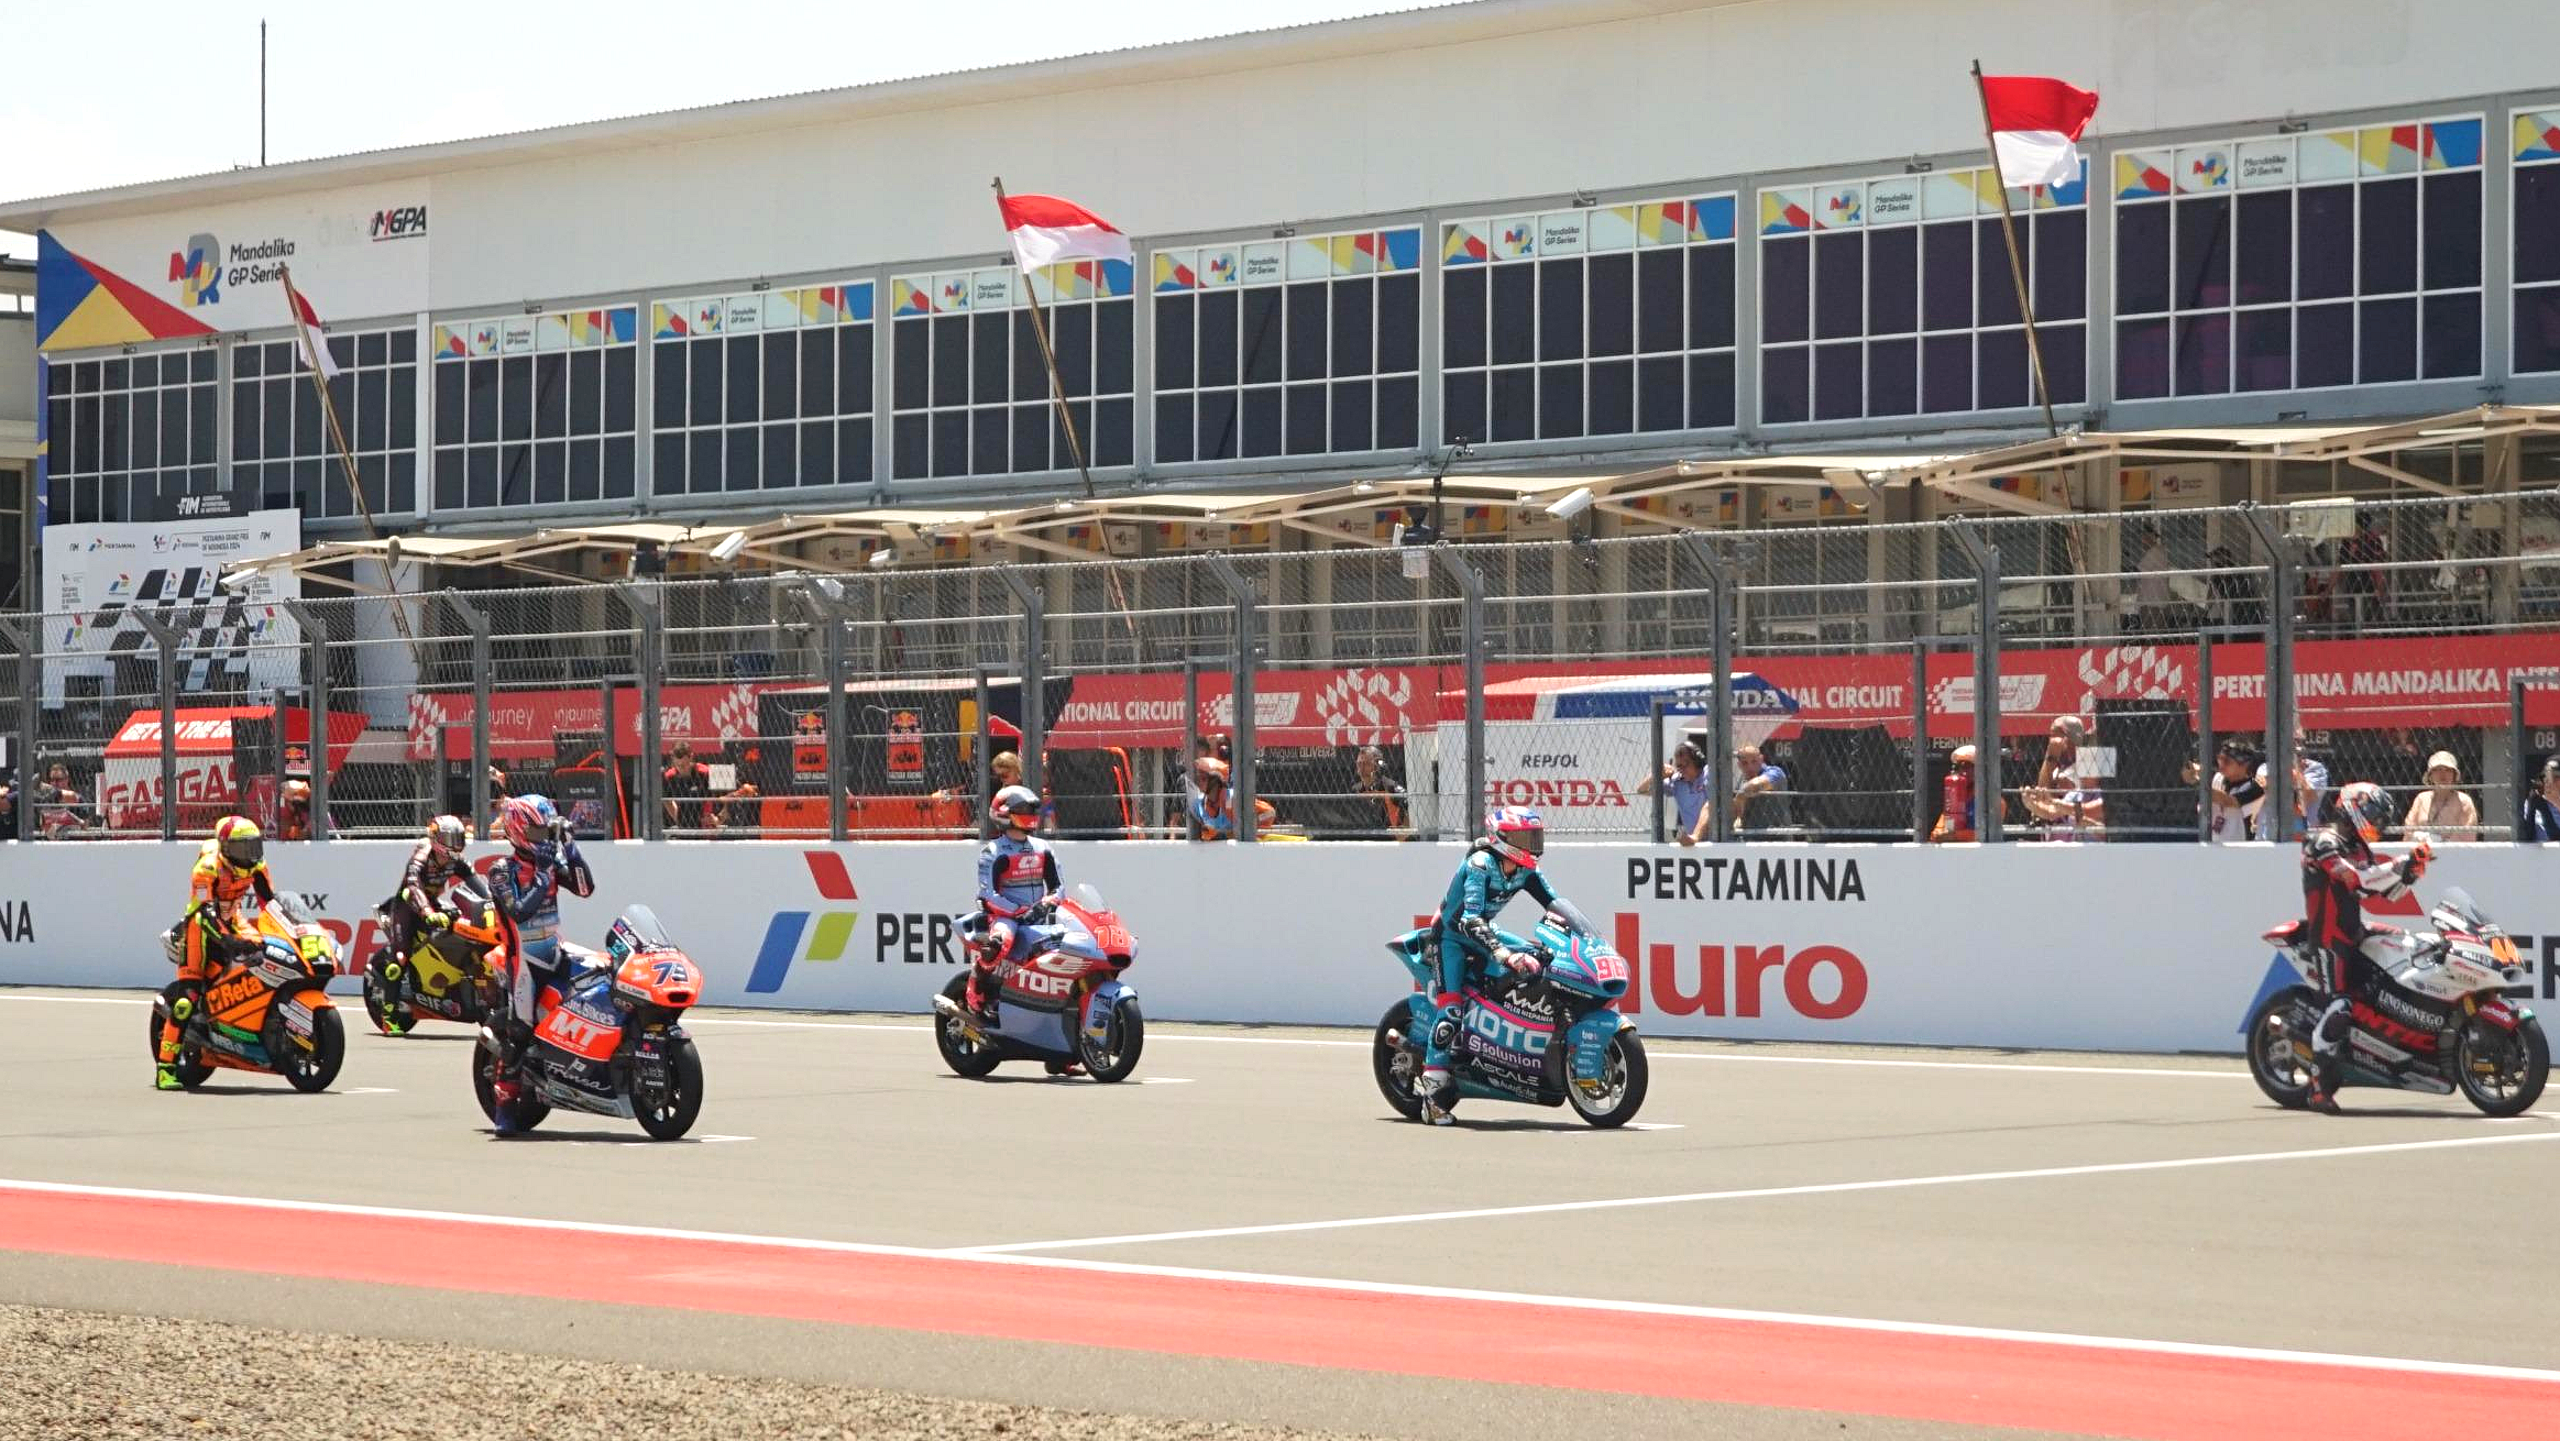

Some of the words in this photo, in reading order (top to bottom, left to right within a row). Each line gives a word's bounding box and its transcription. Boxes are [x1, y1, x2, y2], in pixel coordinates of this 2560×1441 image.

[229, 239, 295, 263] Mandalika
[228, 265, 249, 287] GP
[250, 262, 287, 284] Serie
[2213, 673, 2346, 699] PERTINA
[2351, 668, 2501, 695] MANDALIKA
[1826, 685, 1903, 709] CIRCUIT
[1125, 700, 1187, 721] CIRCUIT
[2535, 731, 2556, 749] 08
[1521, 754, 1580, 768] REPSOL
[1484, 779, 1629, 808] HONDA
[1627, 857, 1866, 901] PERTAMINA
[416, 992, 441, 1011] elf
[548, 1011, 615, 1048] MT
[1482, 1042, 1542, 1069] solunion
